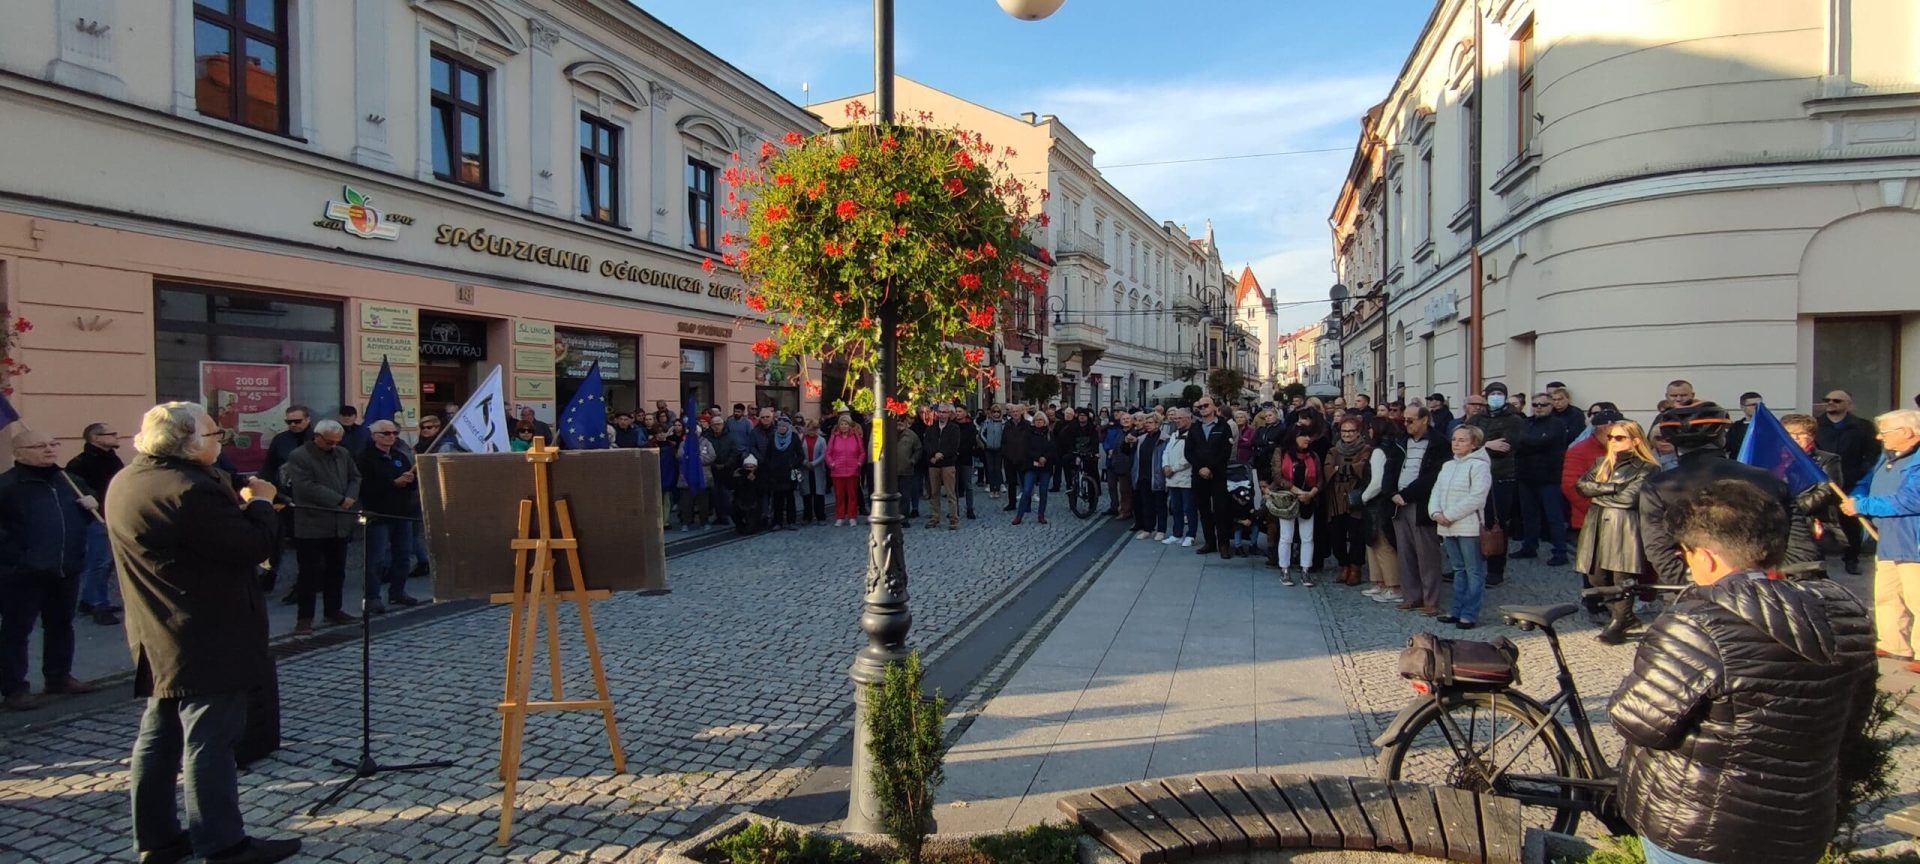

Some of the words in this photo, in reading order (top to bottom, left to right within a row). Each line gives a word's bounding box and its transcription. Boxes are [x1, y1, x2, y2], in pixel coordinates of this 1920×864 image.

[435, 224, 592, 272] SPÓŁDZIELNIA
[367, 337, 412, 345] KANCELARIA
[367, 343, 413, 352] ADWOKACKA
[463, 346, 482, 357] RAJ
[235, 377, 254, 386] 200
[255, 378, 270, 386] GB
[248, 391, 262, 401] 45
